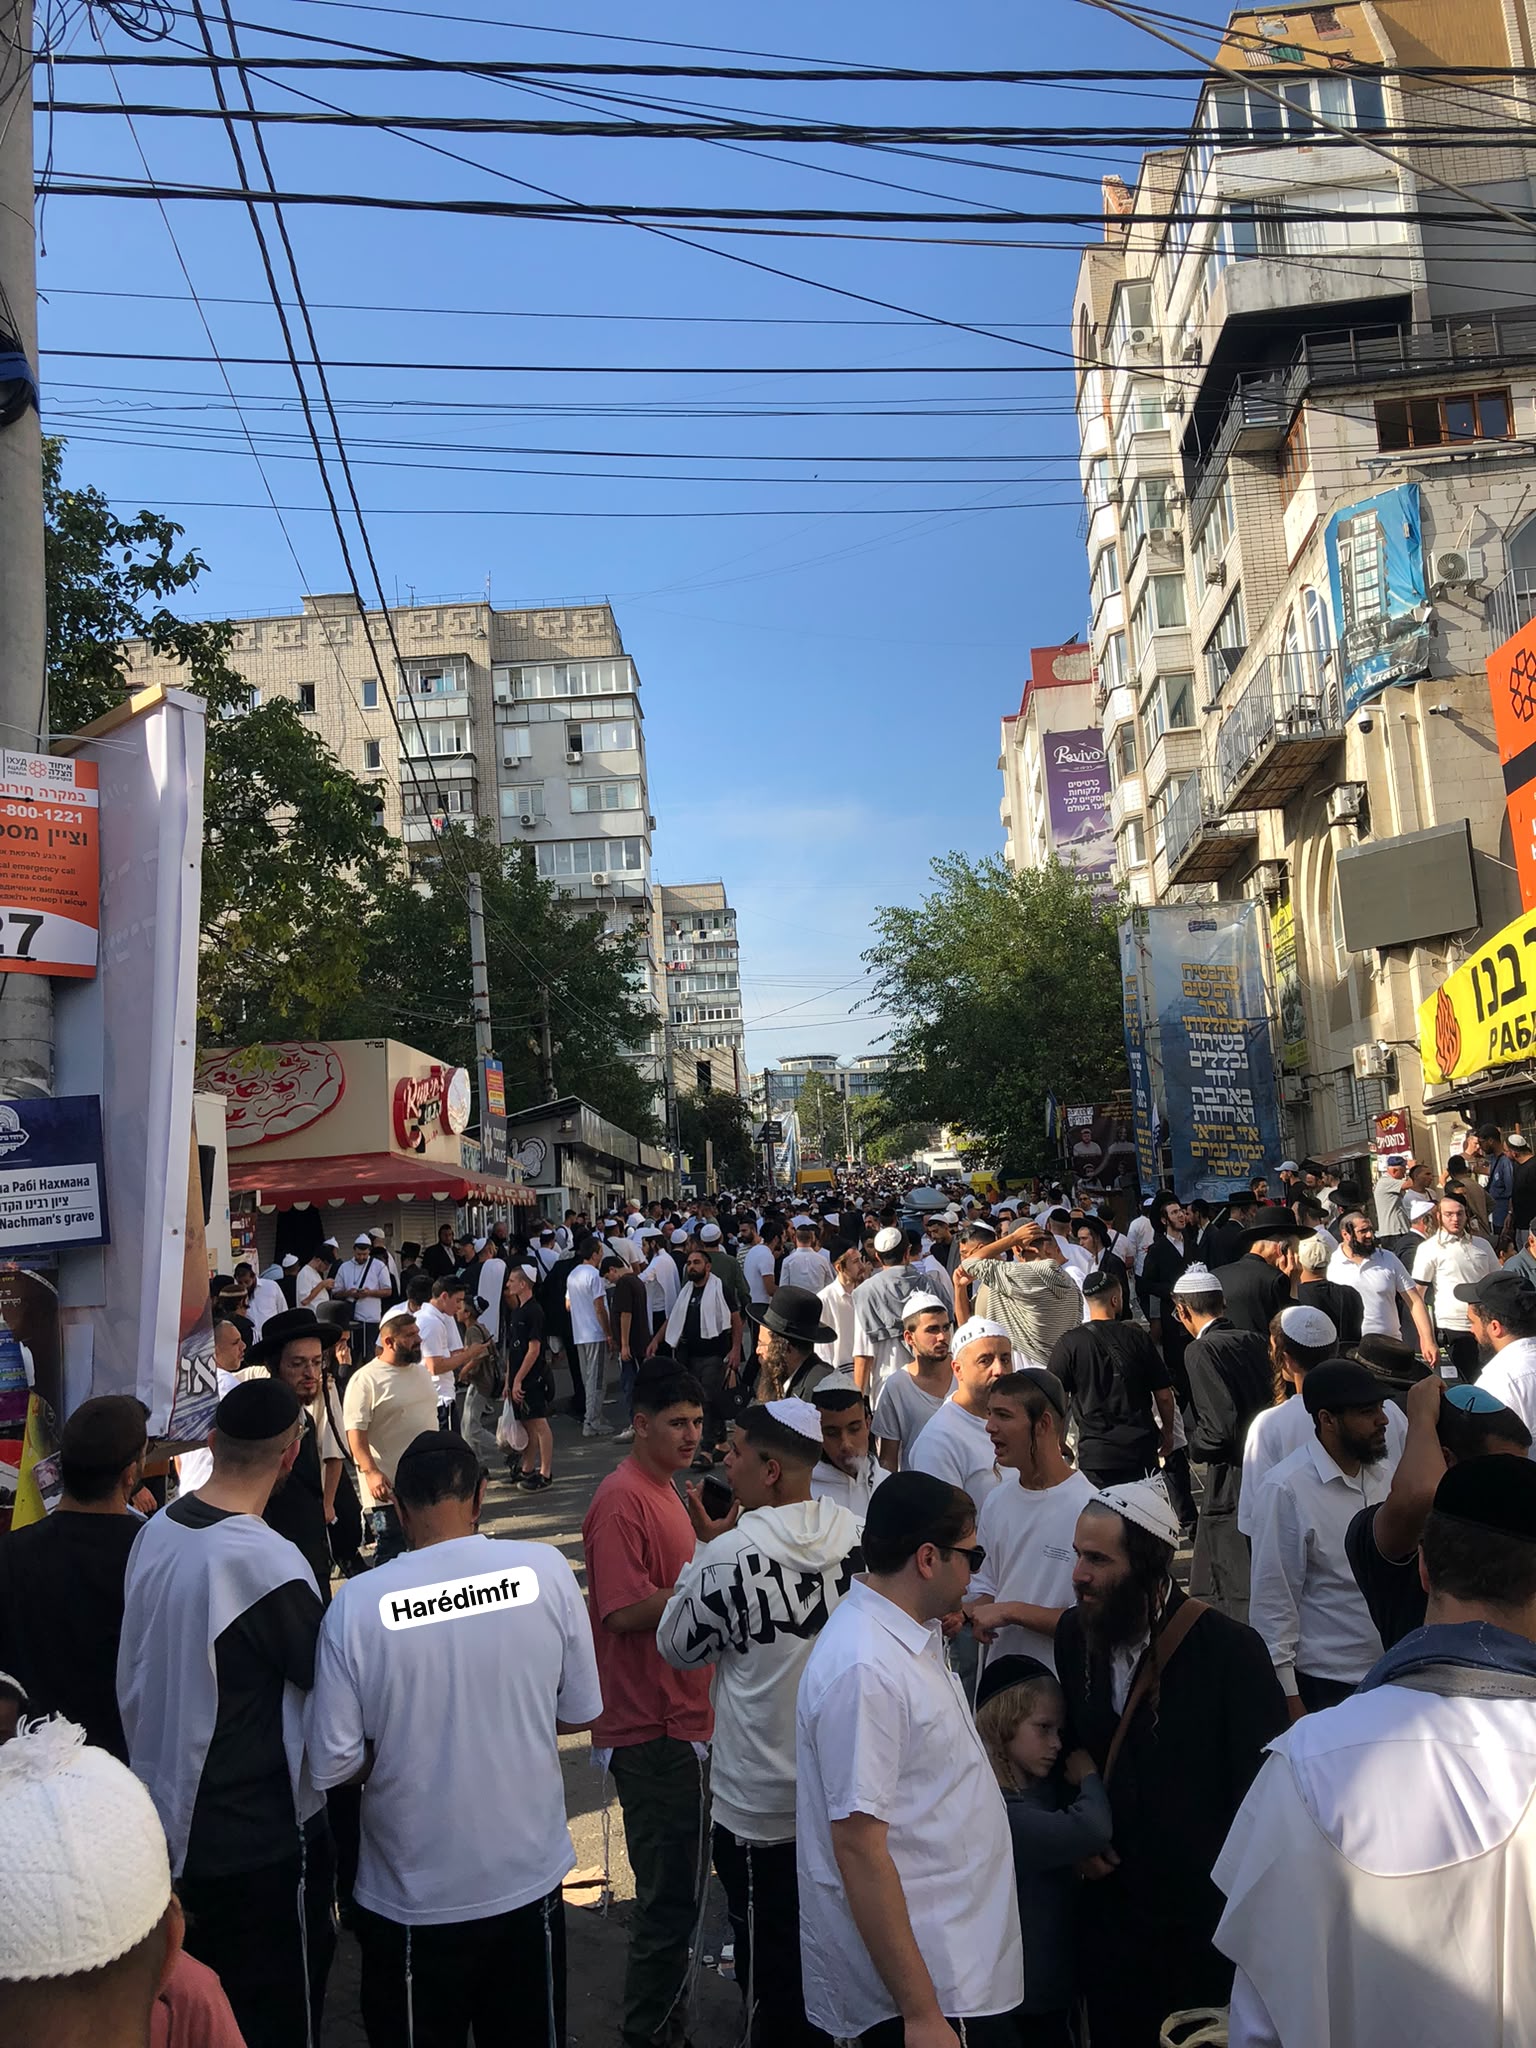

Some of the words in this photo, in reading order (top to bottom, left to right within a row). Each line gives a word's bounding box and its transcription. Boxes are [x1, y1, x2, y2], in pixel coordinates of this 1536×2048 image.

[6, 756, 28, 768] ІХУД
[1054, 745, 1102, 765] Revivo
[48, 761, 73, 771] איחוד
[48, 769, 73, 778] הצלה
[1067, 779, 1100, 789] כרטיסים
[1068, 786, 1101, 797] ללקוחות
[39, 788, 87, 802] במקרה
[1063, 797, 1078, 805] לכל
[1067, 804, 1091, 813] בעולם
[48, 829, 88, 848] וציין
[12, 864, 60, 875] emergency
[61, 867, 76, 875] call
[31, 874, 53, 882] code
[30, 896, 58, 905] номер
[64, 898, 88, 907] місця
[0, 912, 44, 956] 7
[1182, 963, 1239, 981] שהבטיח
[1212, 980, 1241, 999] להם
[1198, 999, 1228, 1016] אחר
[1182, 1015, 1249, 1033] הסתלקותו
[1189, 1032, 1247, 1052] כשיהיו
[1188, 1048, 1250, 1069] נכללים
[1204, 1069, 1237, 1086] יחד
[1191, 1086, 1254, 1106] באהבה
[1193, 1104, 1256, 1124] ואחדות
[1237, 1126, 1260, 1141] אזי
[1190, 1141, 1229, 1158] עמהם
[1231, 1143, 1266, 1160] יגמור
[1207, 1158, 1251, 1177] לטובה
[12, 1179, 37, 1193] Рабі
[39, 1177, 90, 1191] Нахмана
[0, 1200, 23, 1213] הקד
[25, 1198, 49, 1210] רבינו
[51, 1196, 70, 1209] ציון
[64, 1211, 95, 1227] grave
